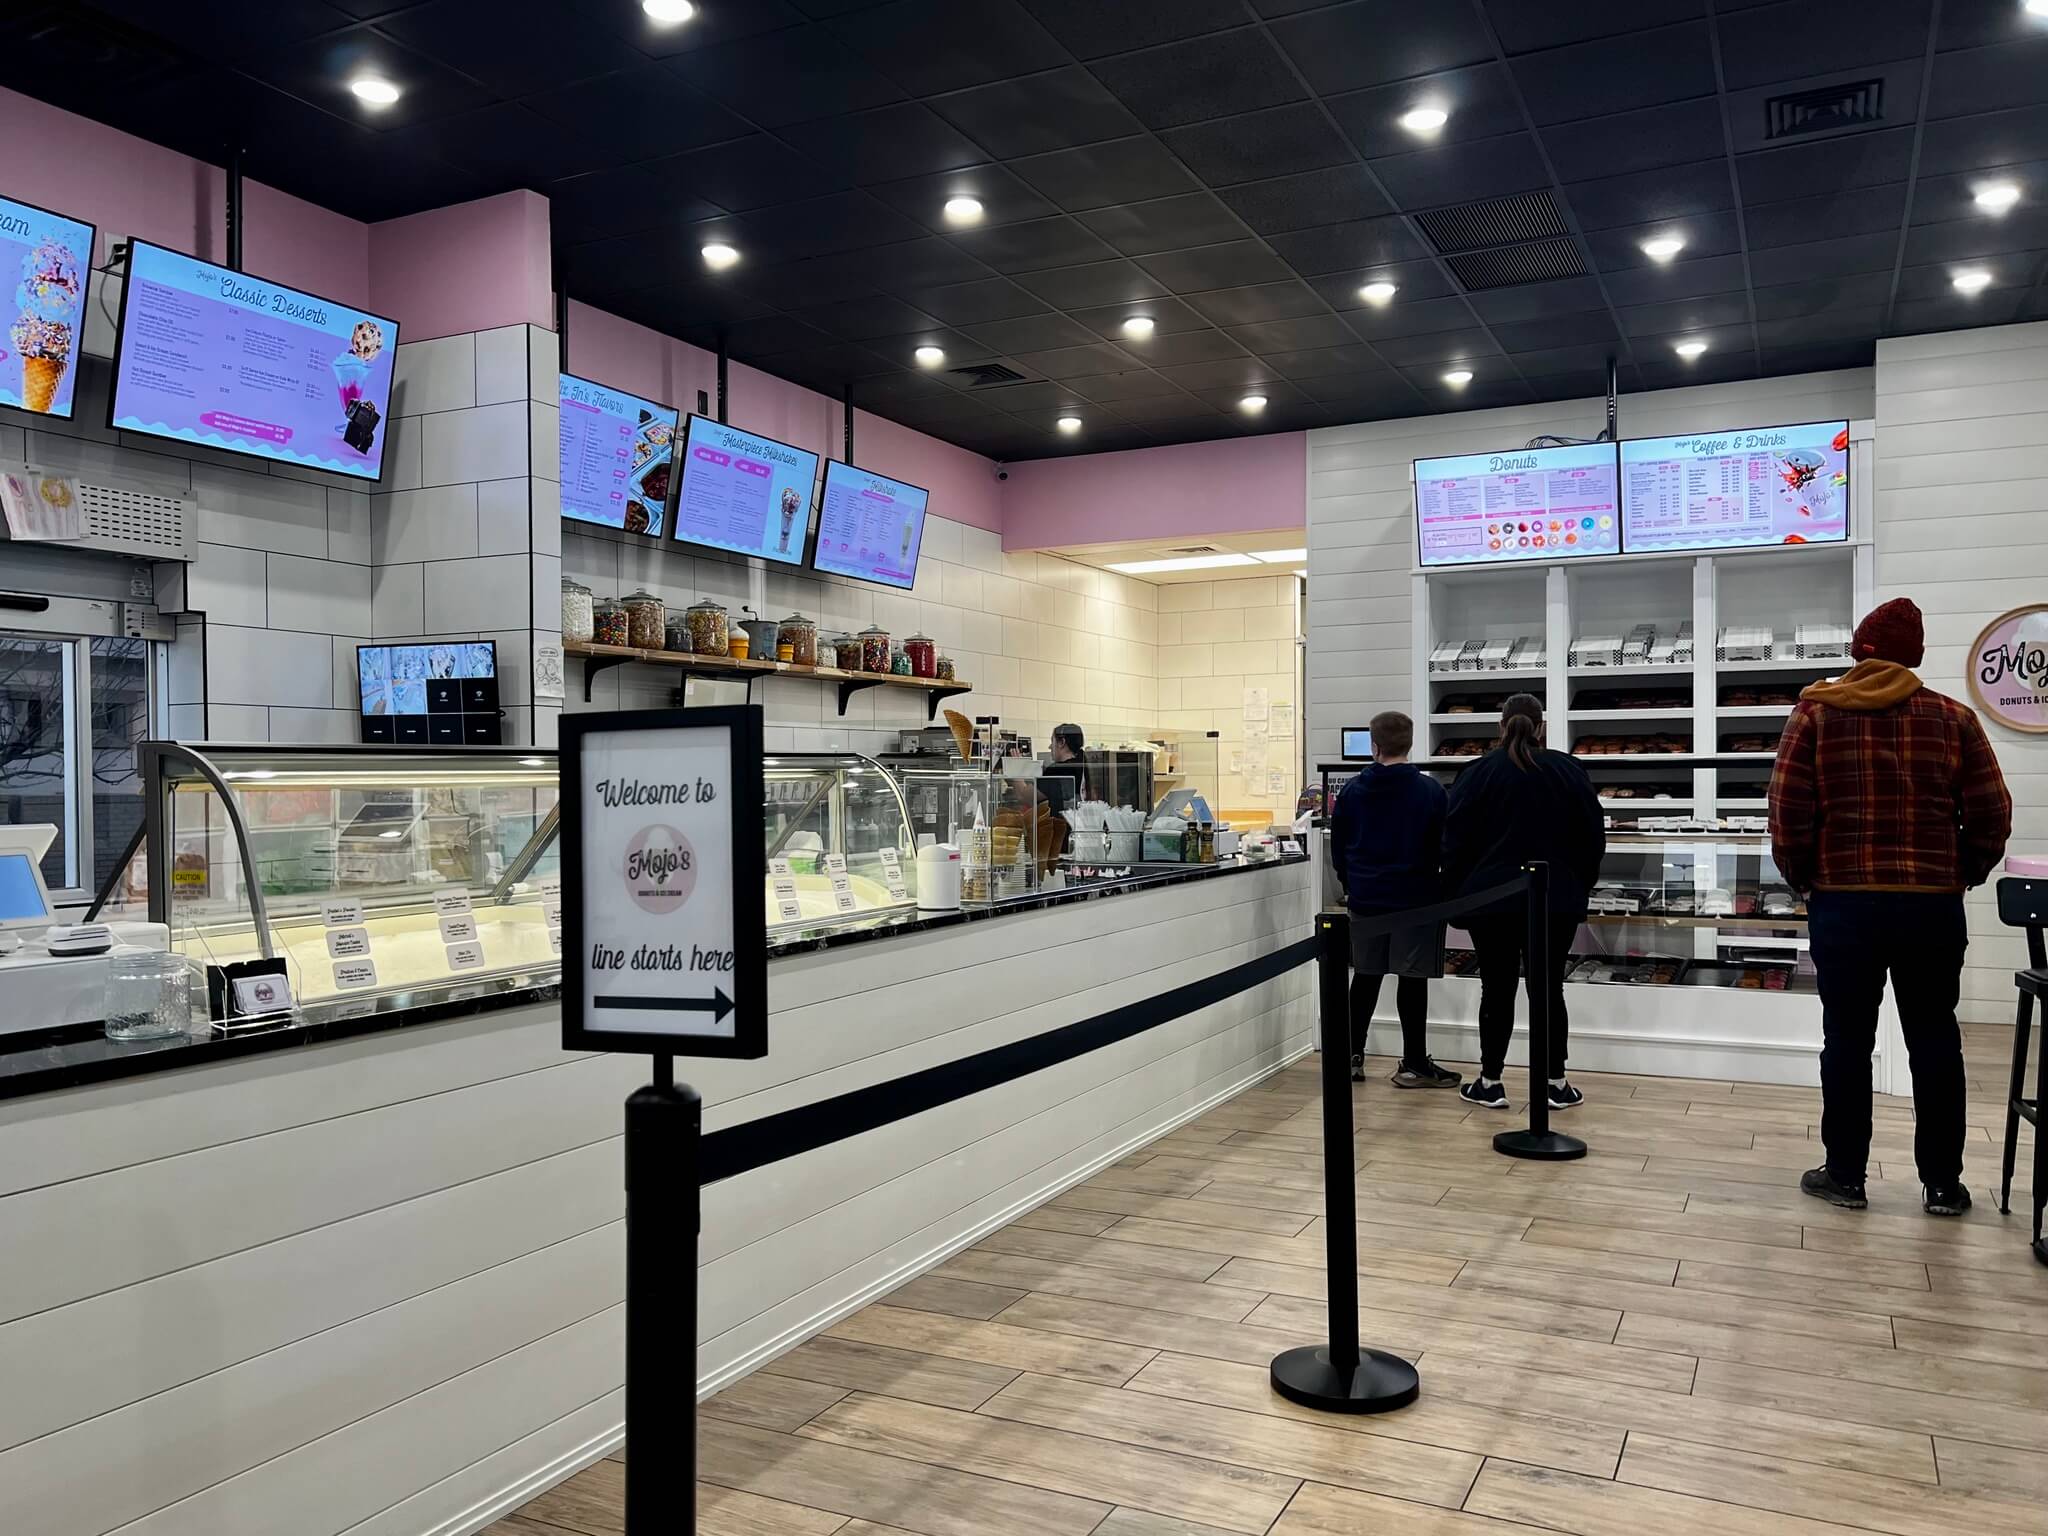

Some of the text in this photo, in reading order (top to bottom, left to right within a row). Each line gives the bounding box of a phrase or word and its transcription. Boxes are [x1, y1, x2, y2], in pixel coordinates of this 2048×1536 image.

[221, 277, 267, 307] Classic
[272, 294, 327, 325] Desserts
[592, 390, 624, 414] Flavors
[722, 432, 762, 455] Masterpiece
[1692, 439, 1728, 455] Coffee
[1733, 436, 1743, 449] &
[1746, 433, 1787, 449] Drinks
[1489, 454, 1538, 472] Donuts
[2000, 696, 2032, 706] DONUTS
[2034, 695, 2040, 704] &
[596, 776, 716, 808] Welcome to
[629, 845, 690, 885] Mojo's
[175, 873, 201, 881] CAUTION
[592, 943, 735, 972] line starts here
